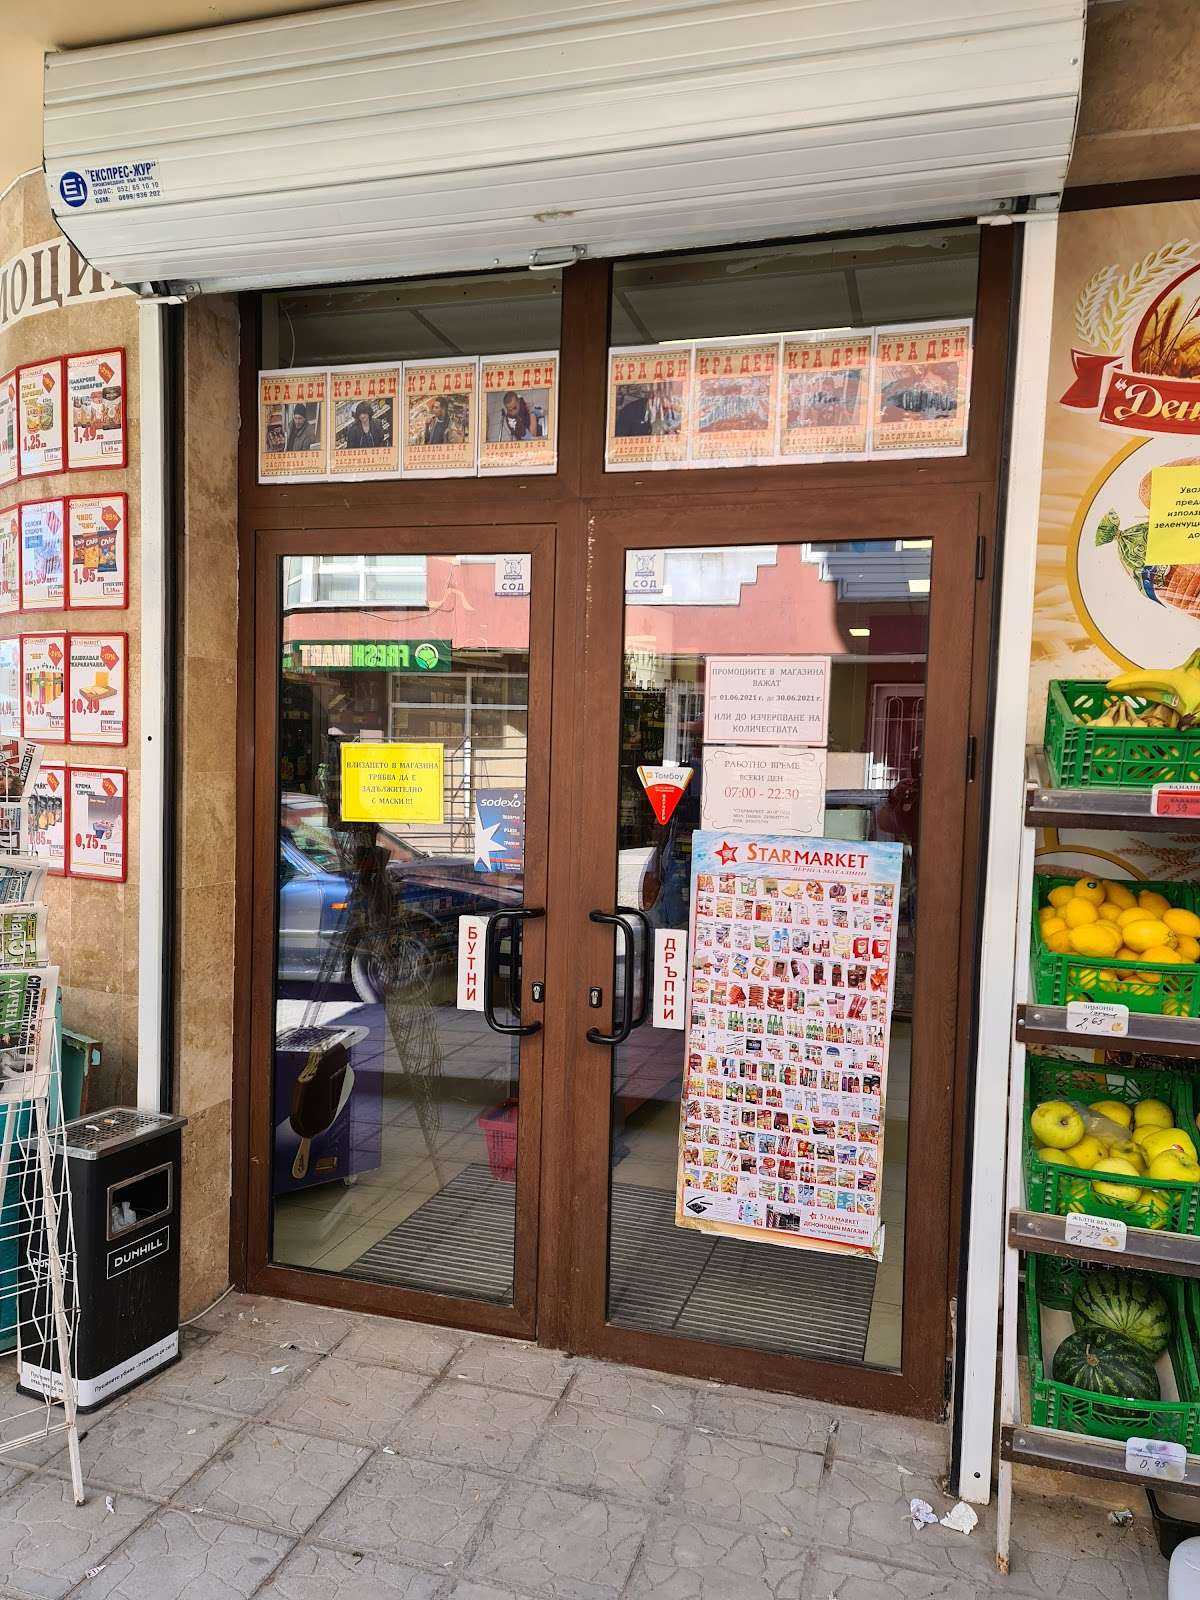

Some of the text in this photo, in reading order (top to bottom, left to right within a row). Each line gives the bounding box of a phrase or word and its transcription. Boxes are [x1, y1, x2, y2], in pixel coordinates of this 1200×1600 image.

[73, 426, 96, 444] 1,49
[24, 434, 41, 451] 1,25
[502, 583, 524, 591] СОД
[633, 580, 657, 588] СОД
[712, 668, 825, 676] ПРОМОЦИИТЕ В МАГАЗИНА
[72, 698, 100, 716] 10,49
[714, 713, 821, 722] ИЛИ ДО ИЗЧЕРПВАНЕ НА
[732, 725, 799, 733] КОЛИЧЕСТВАТА
[724, 760, 800, 769] РАБОТНО ВРЕМЕ
[399, 774, 409, 782] ДА
[740, 774, 764, 782] ВСЕКИ
[724, 786, 756, 799] 07:00
[767, 788, 800, 800] 22:30
[480, 797, 521, 808] sodexo
[75, 833, 99, 850] 0,75
[466, 926, 478, 1001] БУТНИ
[663, 938, 678, 1021] ДРЪПНИ
[841, 1226, 869, 1236] МАГАЗИН
[114, 1238, 163, 1268] DUNHILL
